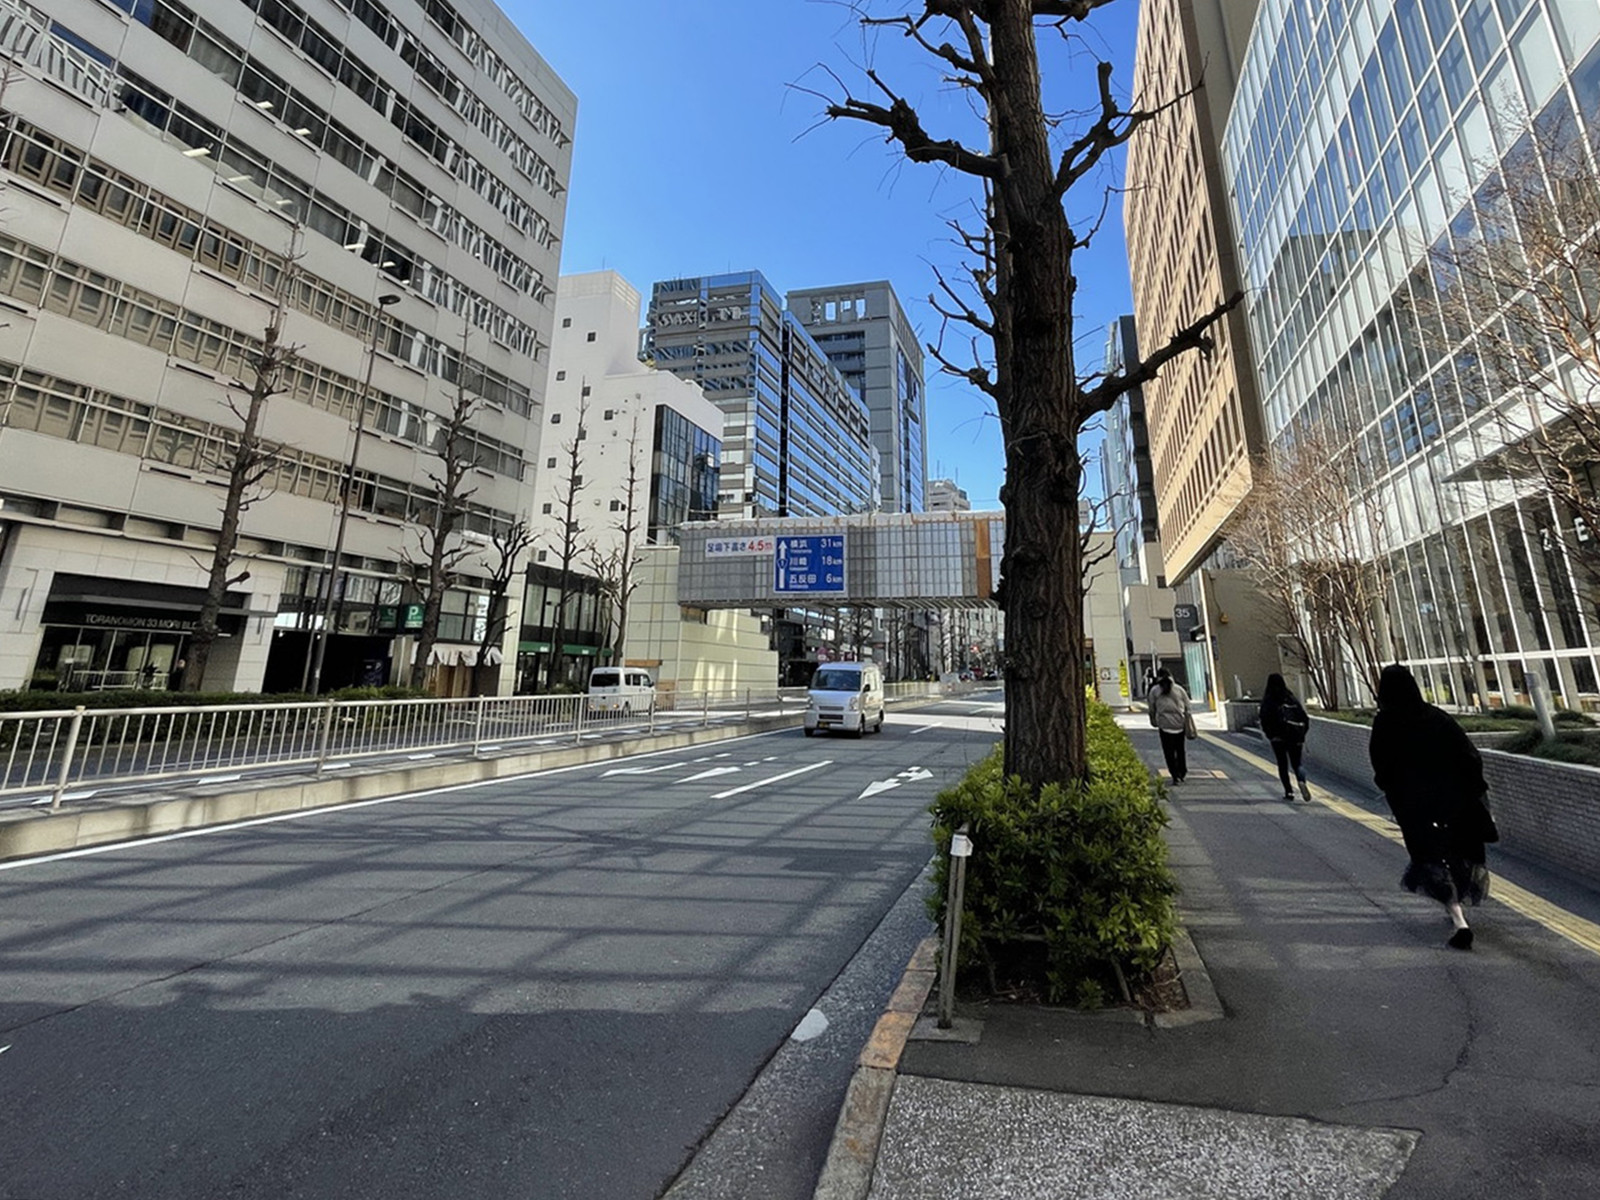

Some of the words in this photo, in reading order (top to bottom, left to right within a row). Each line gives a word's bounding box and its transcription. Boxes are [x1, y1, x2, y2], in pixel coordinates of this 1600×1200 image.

[790, 539, 808, 548] 横浜
[789, 557, 808, 566] 川崎
[789, 574, 817, 584] 五反田
[408, 606, 419, 620] P
[1175, 608, 1190, 618] 35
[158, 619, 180, 629] MORI
